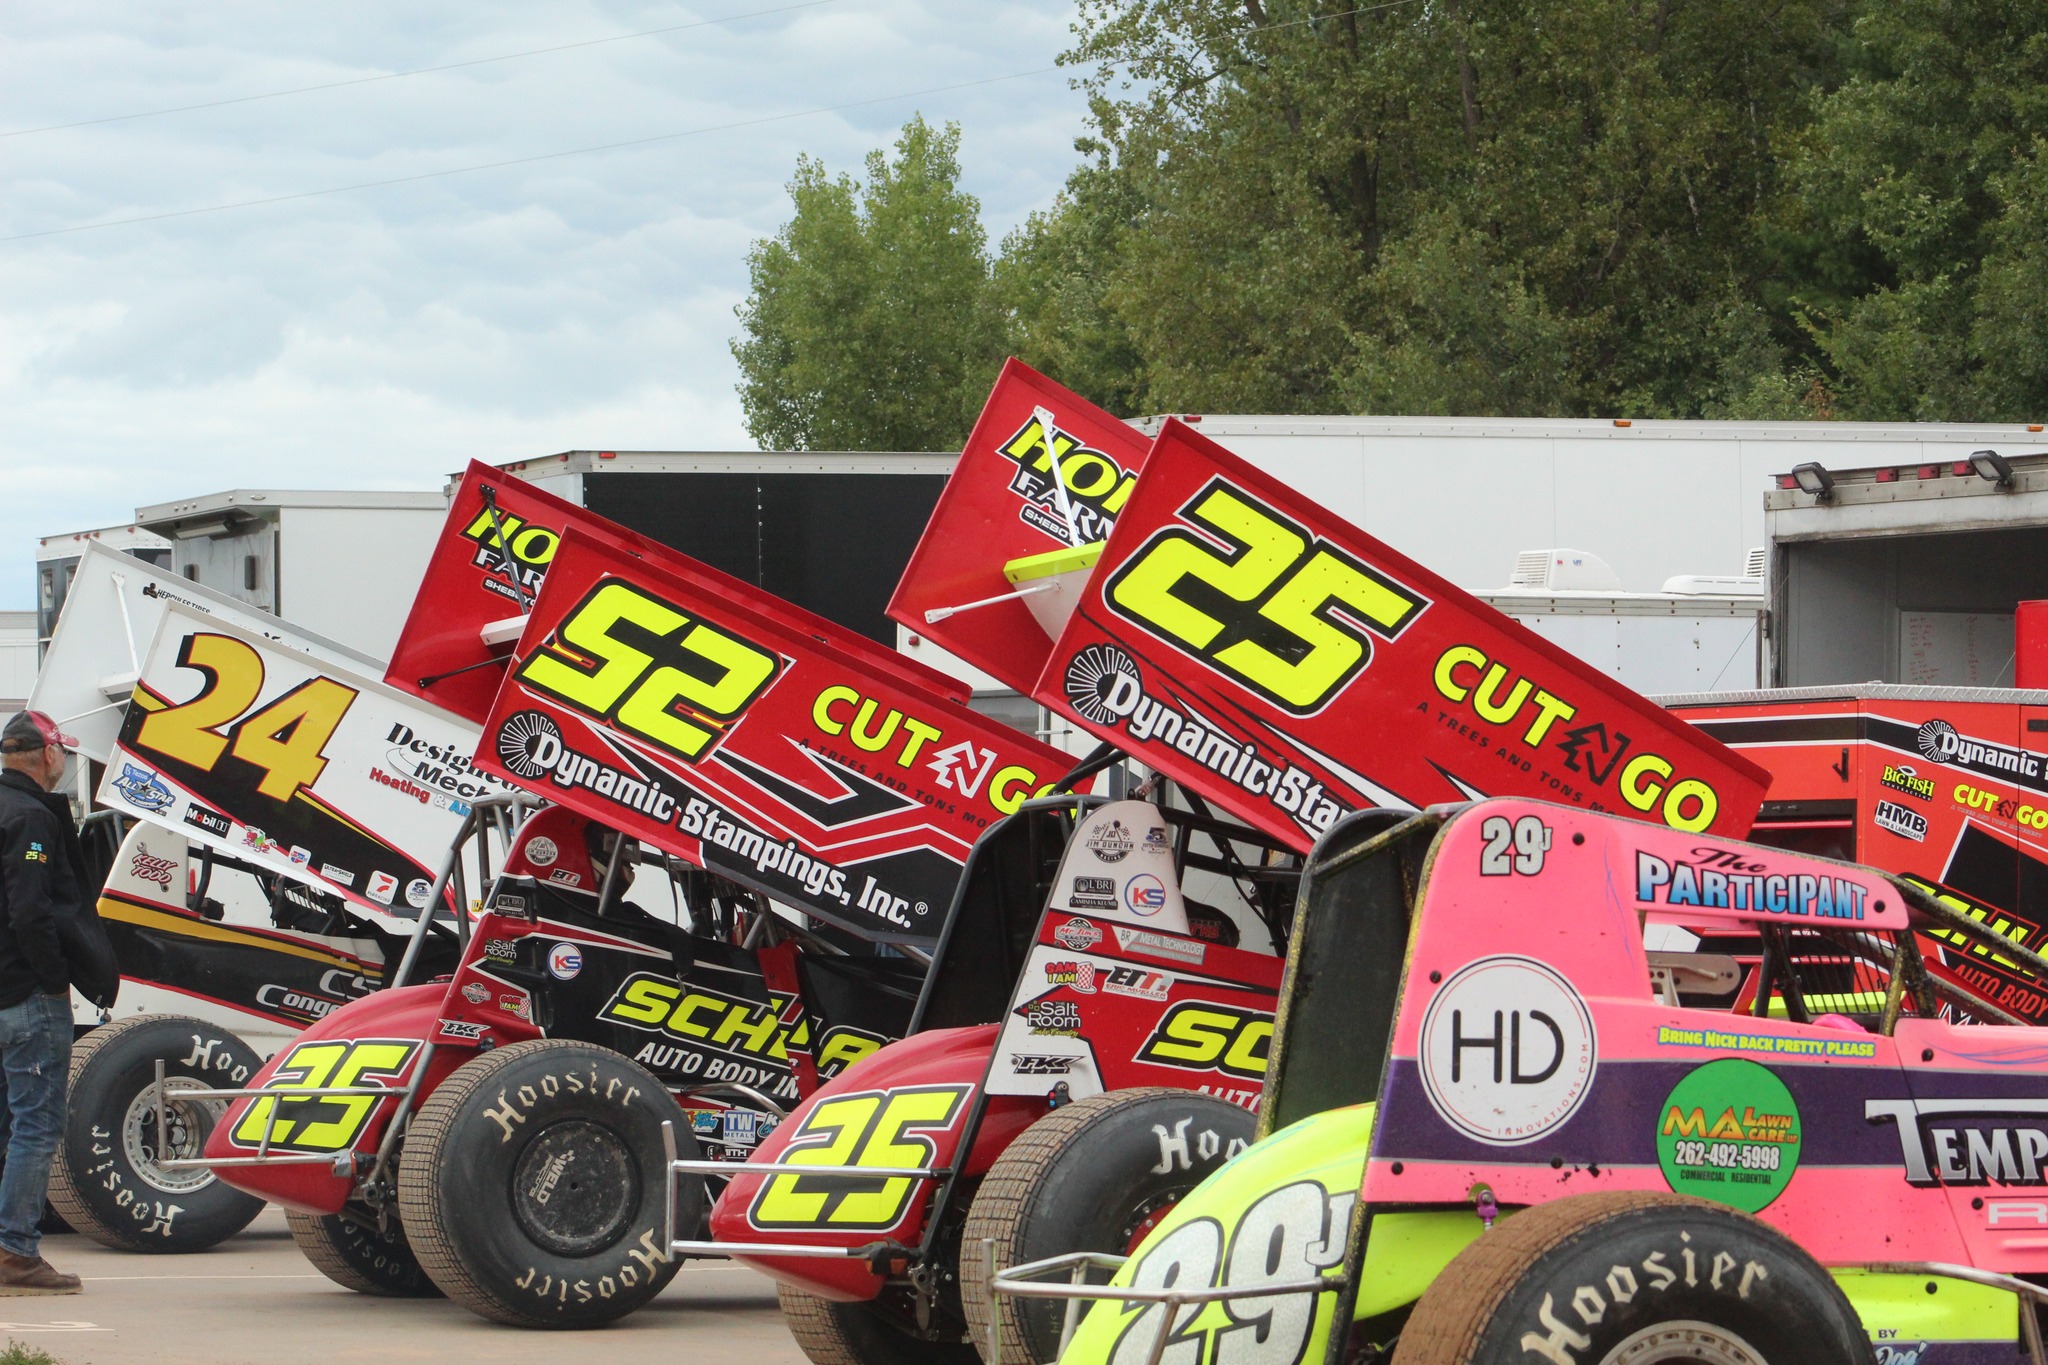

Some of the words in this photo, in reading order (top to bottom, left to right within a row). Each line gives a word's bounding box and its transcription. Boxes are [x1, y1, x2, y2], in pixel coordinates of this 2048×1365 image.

[1105, 476, 1430, 715] 25
[514, 577, 785, 765] 52
[136, 631, 360, 802] 24
[811, 684, 943, 769] CUT
[1102, 670, 1270, 795] Dynamic
[1273, 765, 1351, 833] Sta
[1416, 701, 1429, 713] A
[1436, 711, 1491, 748] TREES
[1495, 746, 1532, 774] AND
[1540, 769, 1584, 802] TONS
[1433, 643, 1578, 749] CUT
[1618, 752, 1719, 833] GO
[1940, 731, 2039, 777] Dynamic
[118, 775, 138, 791] ALL
[146, 790, 174, 804] STAR
[369, 766, 431, 804] Heating
[432, 793, 447, 809] &
[798, 737, 810, 749] A
[817, 744, 868, 775] TREES
[873, 771, 908, 794] AND
[914, 788, 956, 816] TONS
[1881, 780, 1932, 802] CONTRACTING
[1882, 765, 1906, 785] BIG
[1906, 776, 1936, 797] FISH
[187, 808, 216, 827] Mobil
[1877, 801, 1927, 833] HMB
[1953, 784, 1999, 812] CUT
[2016, 805, 2048, 829] GO
[530, 730, 675, 821] Dynamic
[679, 801, 850, 905] Stampings,
[856, 877, 912, 928] Inc.
[1875, 817, 1890, 828] LAWN
[1895, 826, 1923, 841] LANDSCAPE
[25, 851, 38, 860] 25
[31, 842, 43, 852] 26
[1101, 841, 1135, 849] DUNCAN
[1674, 847, 1768, 873] The
[130, 864, 173, 884] TODD
[132, 853, 179, 872] KELLY
[1133, 887, 1165, 906] KS
[1635, 848, 1868, 921] PARTICIPANT
[484, 944, 517, 959] Room
[493, 939, 517, 952] Salt
[1120, 929, 1131, 942] BR
[1140, 932, 1162, 947] METAL
[555, 955, 583, 970] KS
[1045, 961, 1077, 974] SAM
[1048, 974, 1054, 984] I
[1056, 973, 1077, 984] AM
[1126, 987, 1167, 999] MUELLER
[1028, 1012, 1081, 1028] Room
[1040, 1001, 1079, 1017] Salt
[1452, 1009, 1565, 1085] HD
[1658, 1027, 1703, 1046] BRING
[1704, 1028, 1739, 1049] NICK
[1739, 1033, 1774, 1052] BACK
[1775, 1037, 1825, 1055] PRETTY
[1825, 1041, 1875, 1058] PLEASE
[634, 1042, 702, 1075] AUTO
[703, 1058, 775, 1093] BODY
[232, 1041, 420, 1152] 25
[482, 1060, 643, 1144] Hoosier
[1497, 1043, 1589, 1136] INNOVATIONS.COM
[727, 1113, 753, 1131] TW
[1661, 1105, 1747, 1141] MA
[1748, 1128, 1786, 1143] CARE
[750, 1086, 968, 1230] 25
[1674, 1140, 1781, 1171] 262-492-5998
[536, 1157, 568, 1204] WELD
[1680, 1169, 1726, 1182] COMMERCIAL
[1731, 1172, 1772, 1185] RESIDENTIAL
[514, 1227, 673, 1311] Hoosier
[1520, 1230, 1769, 1365] Hoosier
[1878, 1329, 1897, 1339] BY
